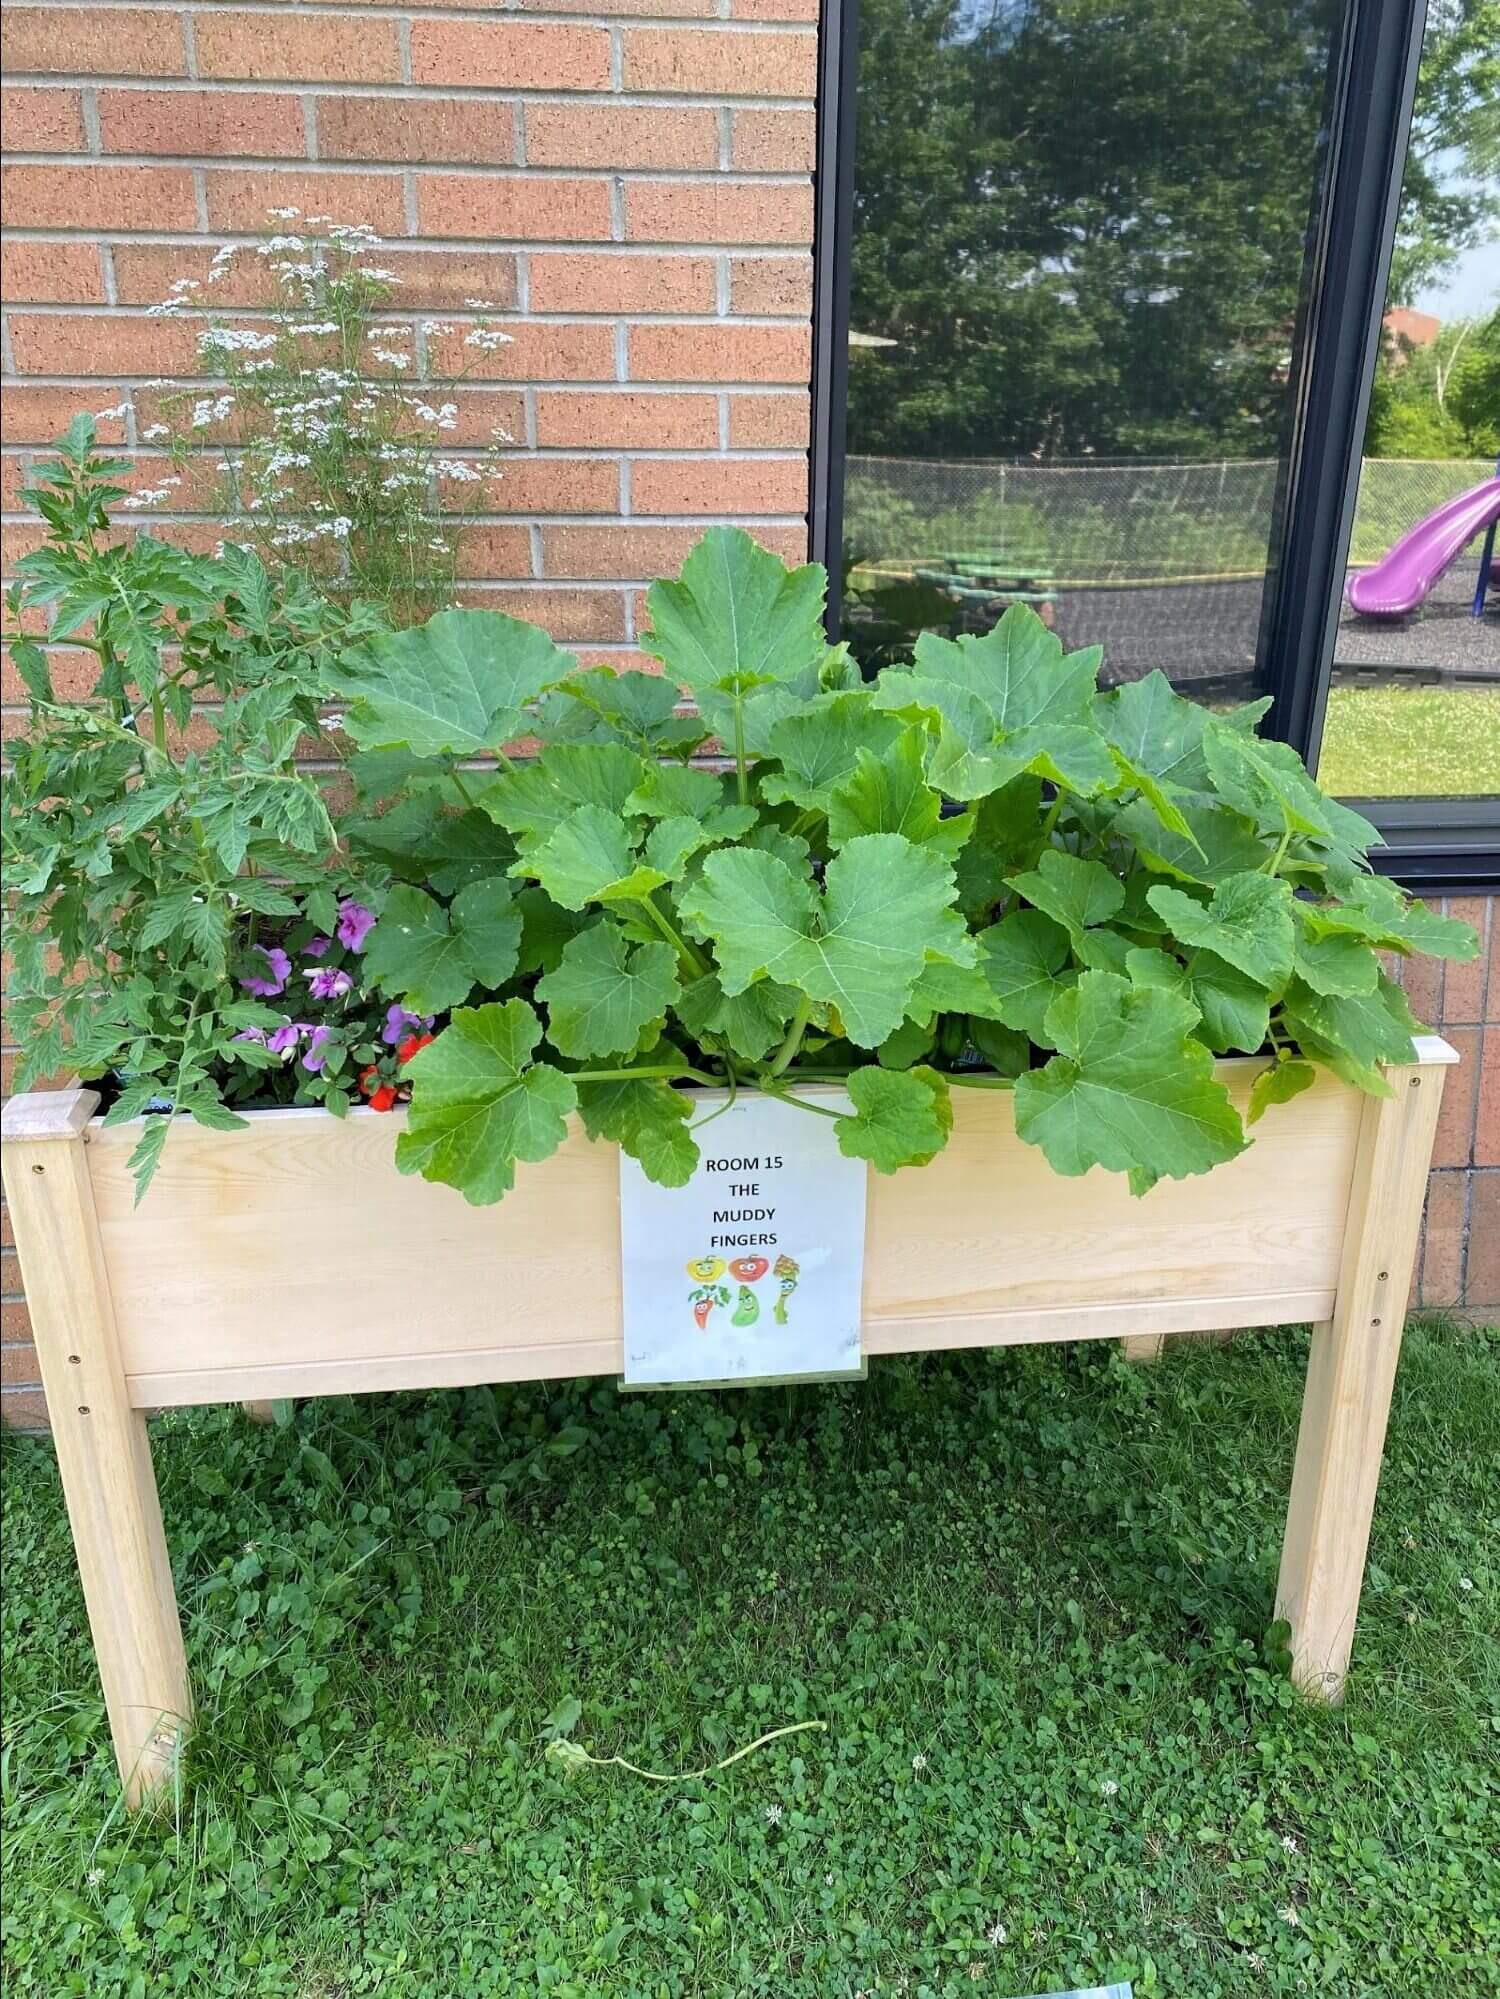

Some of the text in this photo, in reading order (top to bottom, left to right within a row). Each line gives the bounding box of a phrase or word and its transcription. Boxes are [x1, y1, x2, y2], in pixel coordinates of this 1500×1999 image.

[706, 1156, 783, 1172] ROOM 15
[728, 1183, 760, 1196] THE
[713, 1208, 776, 1223] MUDDY
[711, 1233, 777, 1247] FINGERS
